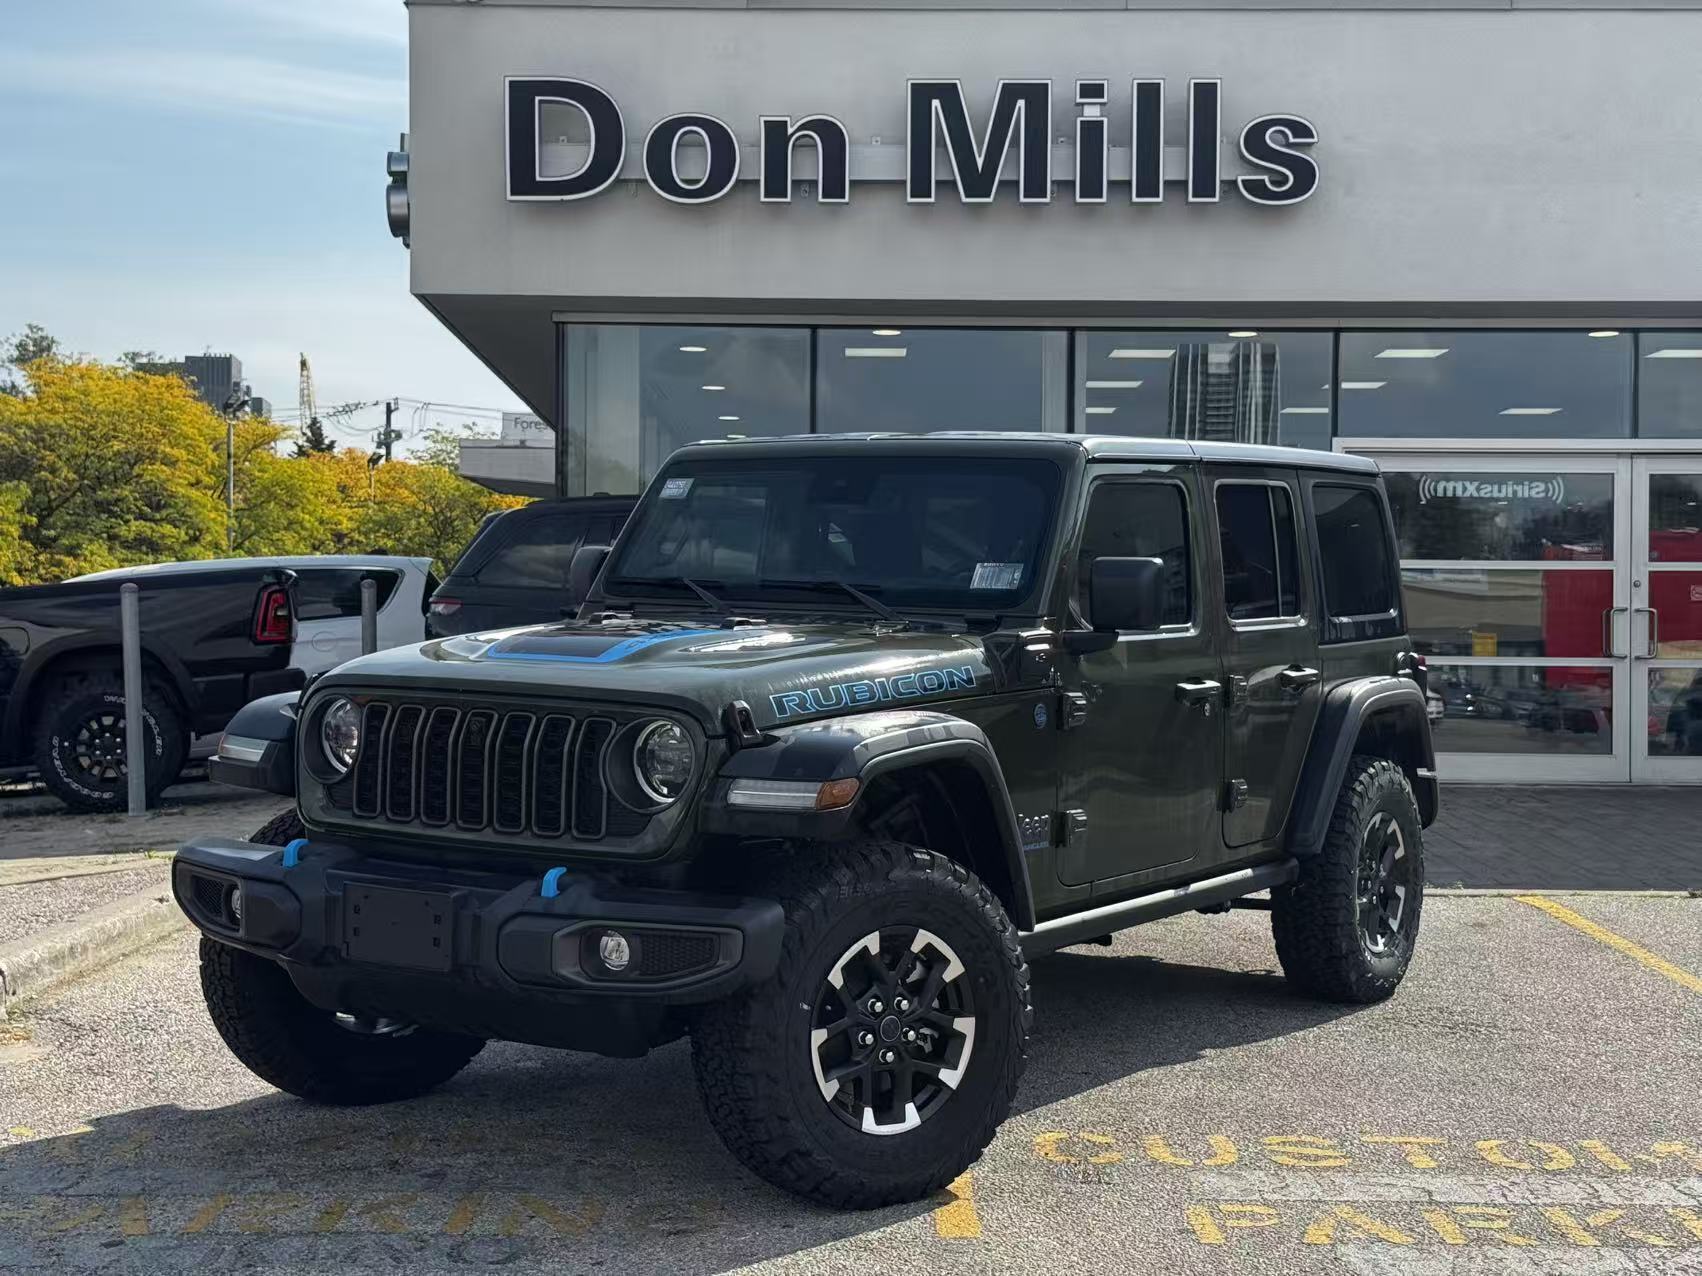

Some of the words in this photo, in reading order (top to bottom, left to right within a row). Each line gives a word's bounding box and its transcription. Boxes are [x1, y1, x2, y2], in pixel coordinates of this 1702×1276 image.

[503, 75, 850, 205] Don
[906, 77, 1320, 206] Mills
[769, 665, 977, 718] RUBICON
